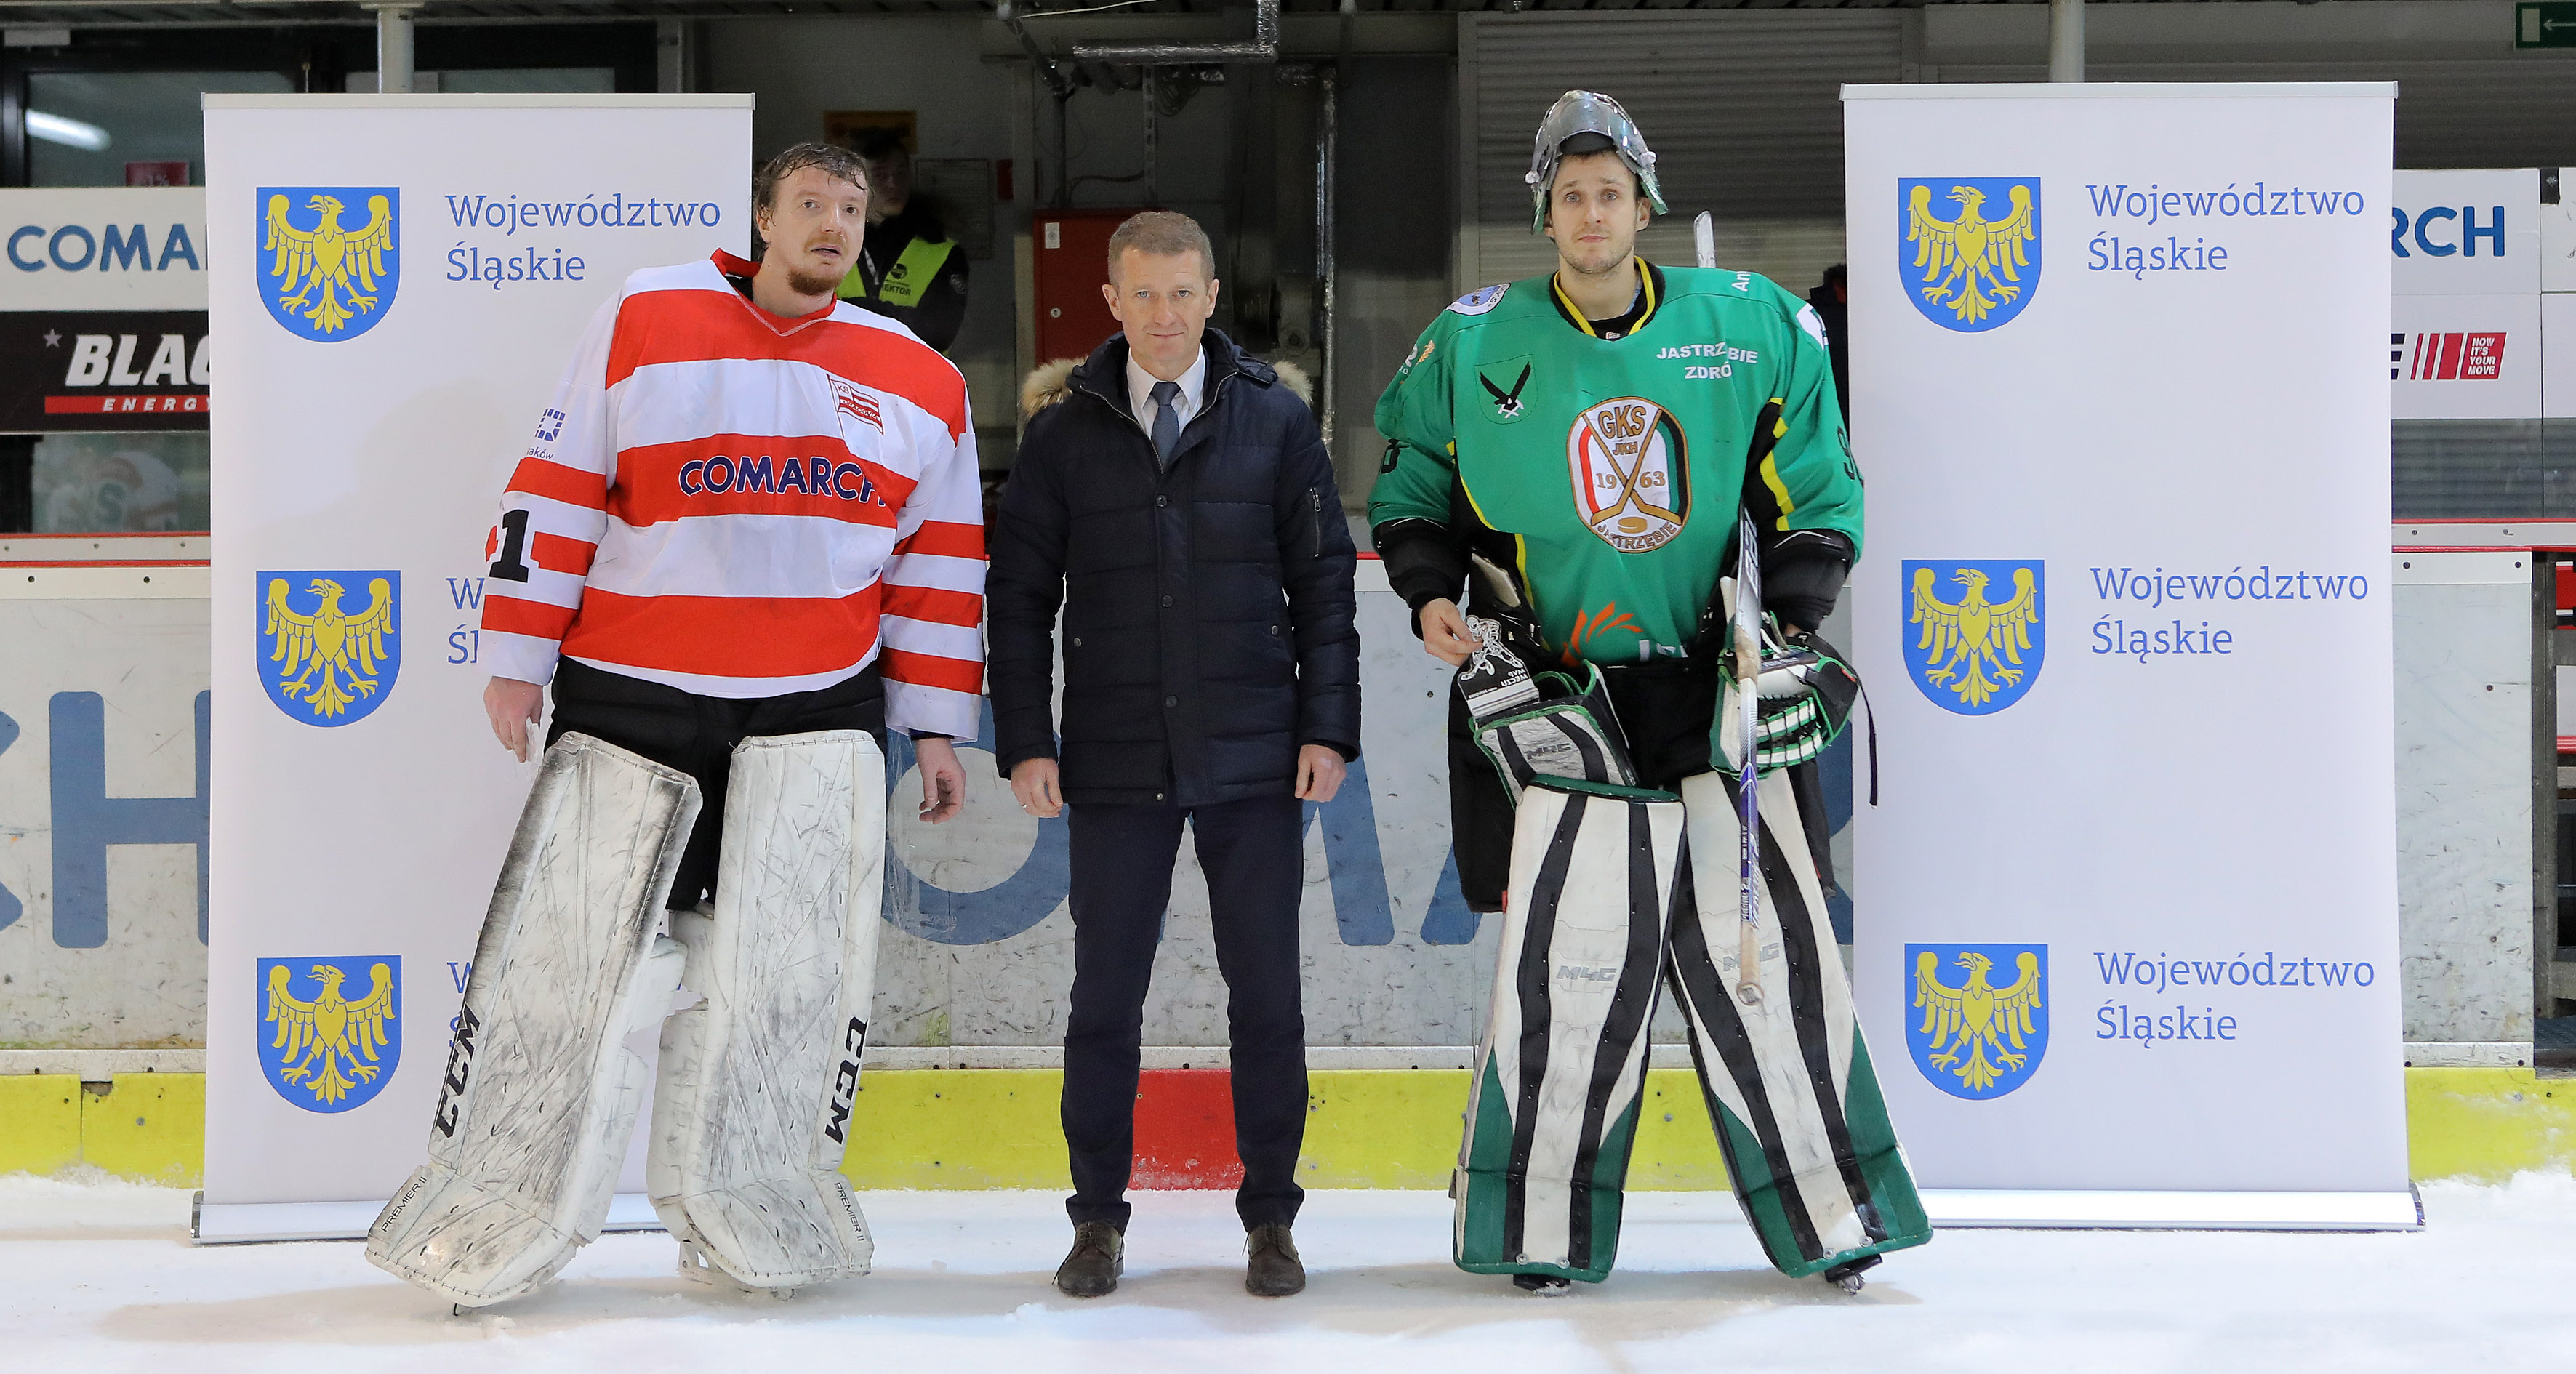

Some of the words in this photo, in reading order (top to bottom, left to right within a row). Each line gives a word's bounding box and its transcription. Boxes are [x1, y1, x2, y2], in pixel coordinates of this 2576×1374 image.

[445, 193, 721, 236] Województwo
[2086, 182, 2364, 225] Województwo
[7, 223, 208, 272] COMA
[446, 241, 585, 291] Śląskie
[2088, 230, 2228, 281] Śląskie
[1656, 342, 1759, 364] JASTRZBIE
[2470, 347, 2489, 355] IT'S
[2470, 356, 2496, 366] YOUR
[2472, 337, 2495, 347] NOW
[2468, 366, 2495, 375] MOVE
[103, 397, 210, 411] ENERG
[1597, 405, 1646, 438] GKS
[1612, 441, 1638, 456] JKH
[1596, 473, 1617, 489] 19
[1640, 470, 1666, 489] 63
[2090, 566, 2368, 608] Województwo
[2092, 614, 2233, 664] Śląskie
[1722, 942, 1780, 972] MG
[2094, 952, 2375, 995] Województwo
[2096, 999, 2237, 1049] Śląskie
[436, 1002, 481, 1138] CCM
[824, 1016, 869, 1145] CCM
[380, 1183, 422, 1232] PREMIER
[834, 1182, 862, 1233] PREMIER
